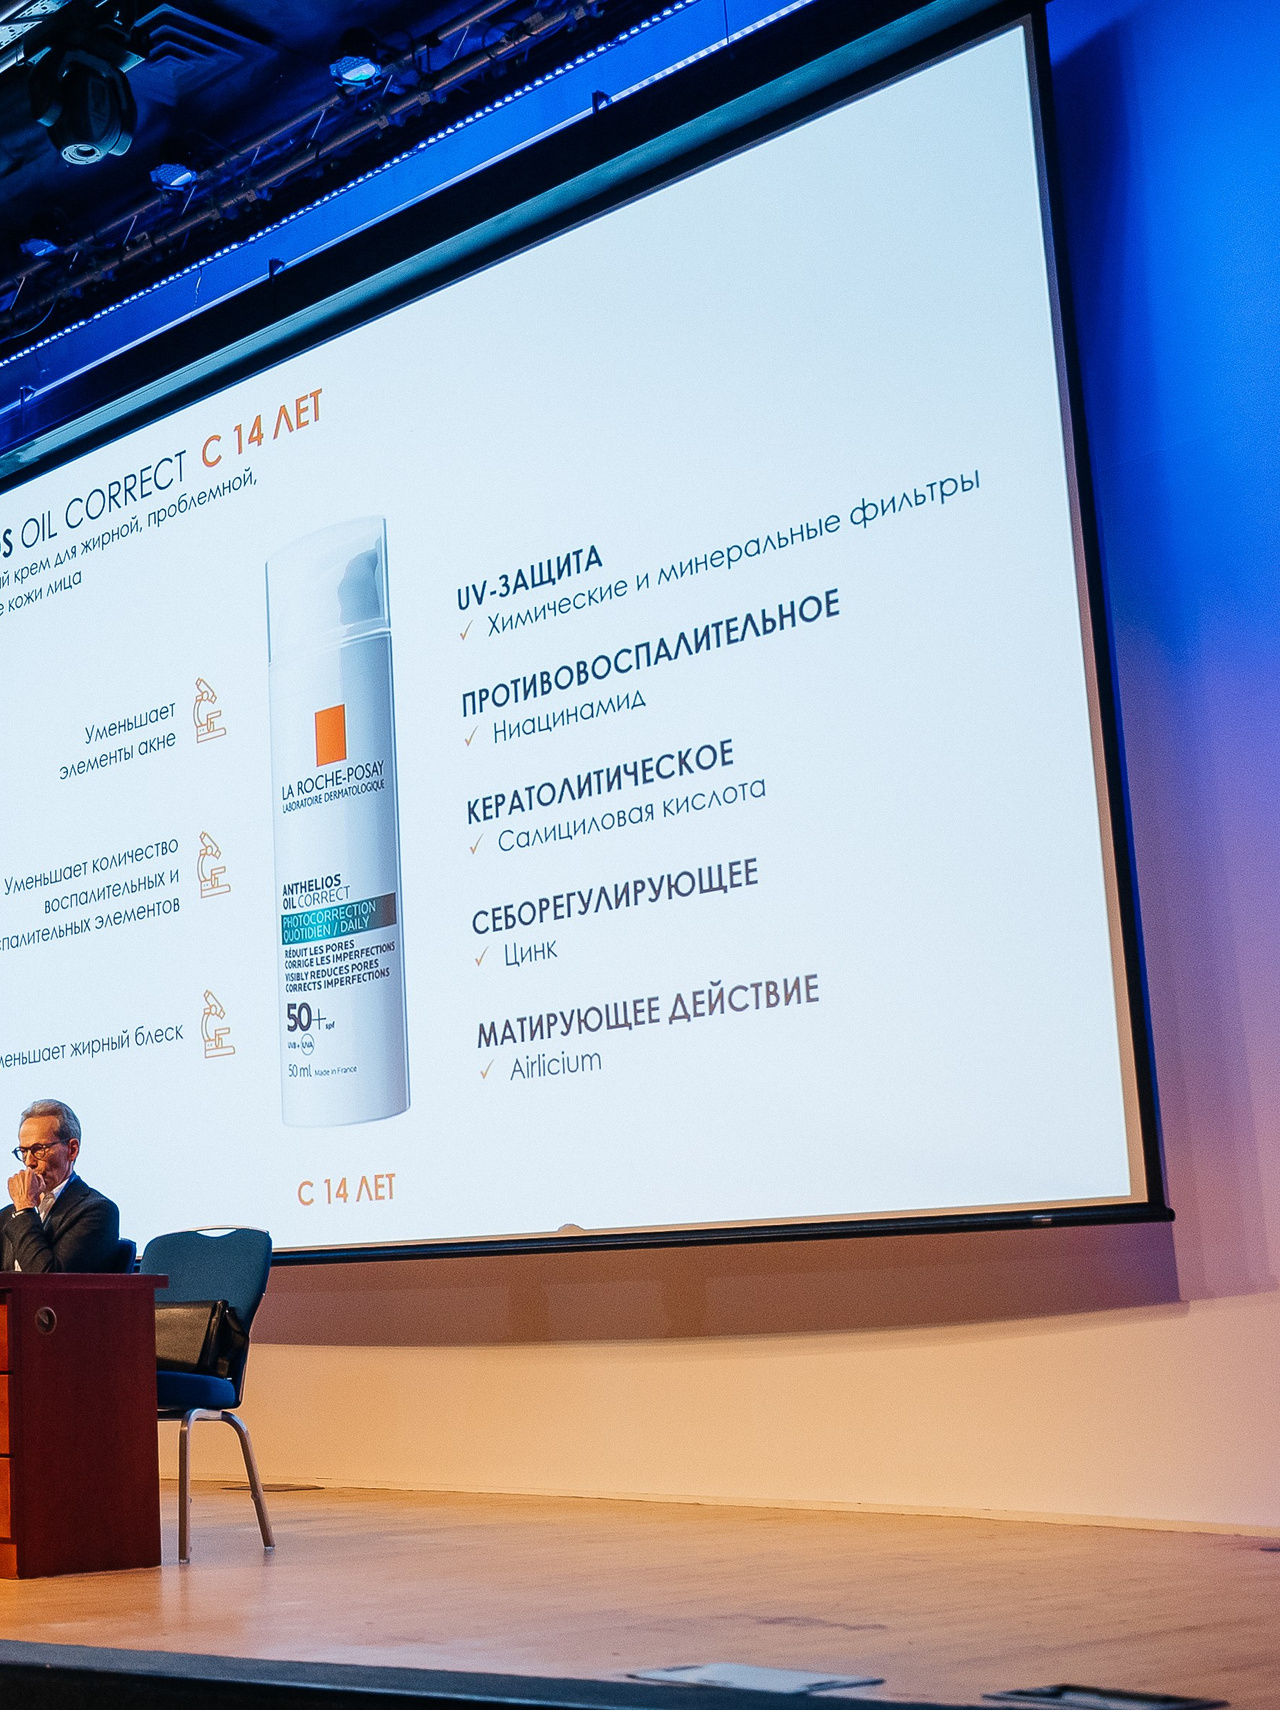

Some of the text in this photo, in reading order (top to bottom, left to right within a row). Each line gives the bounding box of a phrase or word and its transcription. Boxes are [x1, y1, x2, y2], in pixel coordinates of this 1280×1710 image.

[20, 511, 58, 548] OIL
[65, 450, 186, 530] CORRECT
[201, 435, 222, 467] С
[234, 415, 264, 454] 14
[273, 388, 323, 440] ЛЕТ
[14, 555, 51, 588] крем
[54, 544, 77, 569] для
[80, 515, 143, 555] жирной,
[147, 468, 258, 526] проблемной,
[488, 470, 981, 637] Химические и минеральные фильтры
[9, 587, 43, 617] кожи
[46, 570, 82, 599] лица
[457, 544, 603, 610] UV-ЗАЩИТА
[462, 588, 841, 717] ПРОТИВОВОСПАЛИТЕЛЬНОЕ
[85, 703, 176, 744] Уменьшает
[493, 689, 646, 744] Ниацинамид
[59, 732, 176, 780] элементы акне
[282, 760, 384, 801] LA ROCHE-POSAY
[282, 779, 385, 813] LABORATOIRE DERMATOLOGIQUE
[467, 739, 734, 824] КЕРАТОЛИТИЧЕСКОЕ
[498, 778, 766, 852] Салициловая кислота
[4, 838, 179, 897] Уменьшает количество
[282, 874, 341, 896] ANTHELIOS
[44, 870, 179, 915] воспалительных и
[282, 886, 350, 910] OIL CORRECT
[472, 857, 759, 935] СЕБОРЕГУЛИРУЮЩЕЕ
[95, 897, 180, 930] элементов
[283, 901, 376, 929] PHOTOCORRECTION
[283, 923, 331, 942] QUOTIDIEN
[340, 916, 370, 933] DAILY
[285, 939, 355, 958] RÉDUIT LES PORES
[285, 941, 396, 969] CORRIGE LES IMPERFECTIONS
[504, 940, 558, 967] Цинк
[285, 958, 379, 982] VISIBLY REDUCES PORES
[285, 967, 391, 993] CORRECTS IMPERFECTIONS
[477, 973, 820, 1048] МАТИРУЮЩЕЕ ДЕЙСТВИЕ
[70, 1029, 129, 1058] жирный
[135, 1023, 184, 1045] блеск
[288, 1064, 298, 1078] 50
[299, 1064, 312, 1077] ml
[337, 1065, 357, 1074] France
[511, 1050, 602, 1081] Airlicium
[297, 1172, 396, 1206] С 14 ЛЕТ
